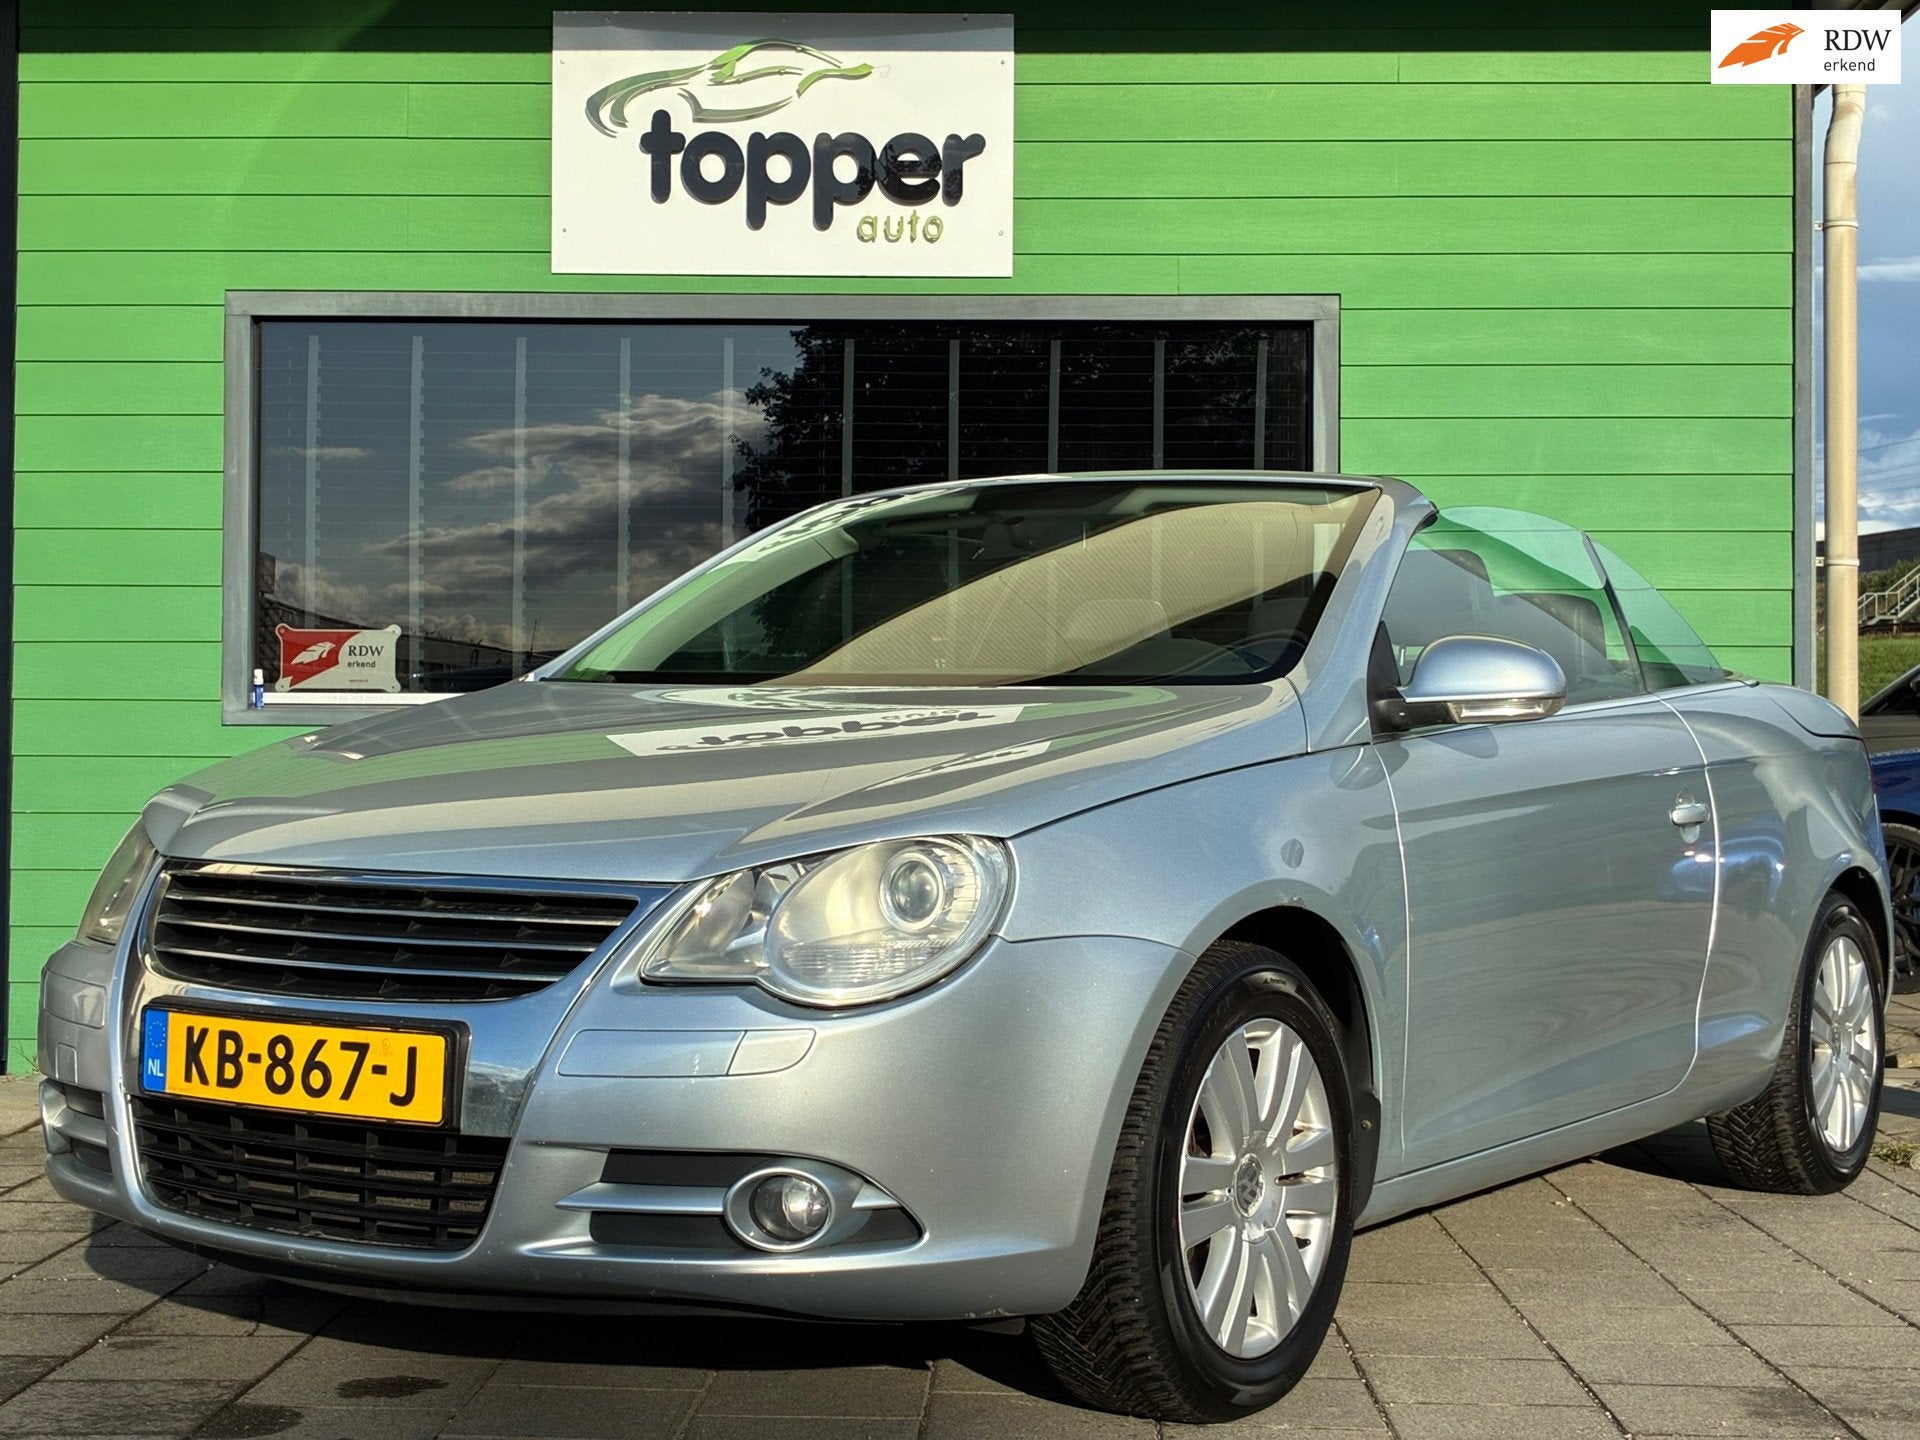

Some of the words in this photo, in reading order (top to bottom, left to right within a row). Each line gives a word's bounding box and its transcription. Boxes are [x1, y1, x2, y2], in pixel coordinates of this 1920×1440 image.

[638, 109, 986, 231] topper
[856, 209, 944, 243] auto
[347, 644, 384, 657] RDW
[347, 660, 376, 668] erkend
[147, 1058, 164, 1078] NL
[184, 1024, 418, 1108] KB-867-J
